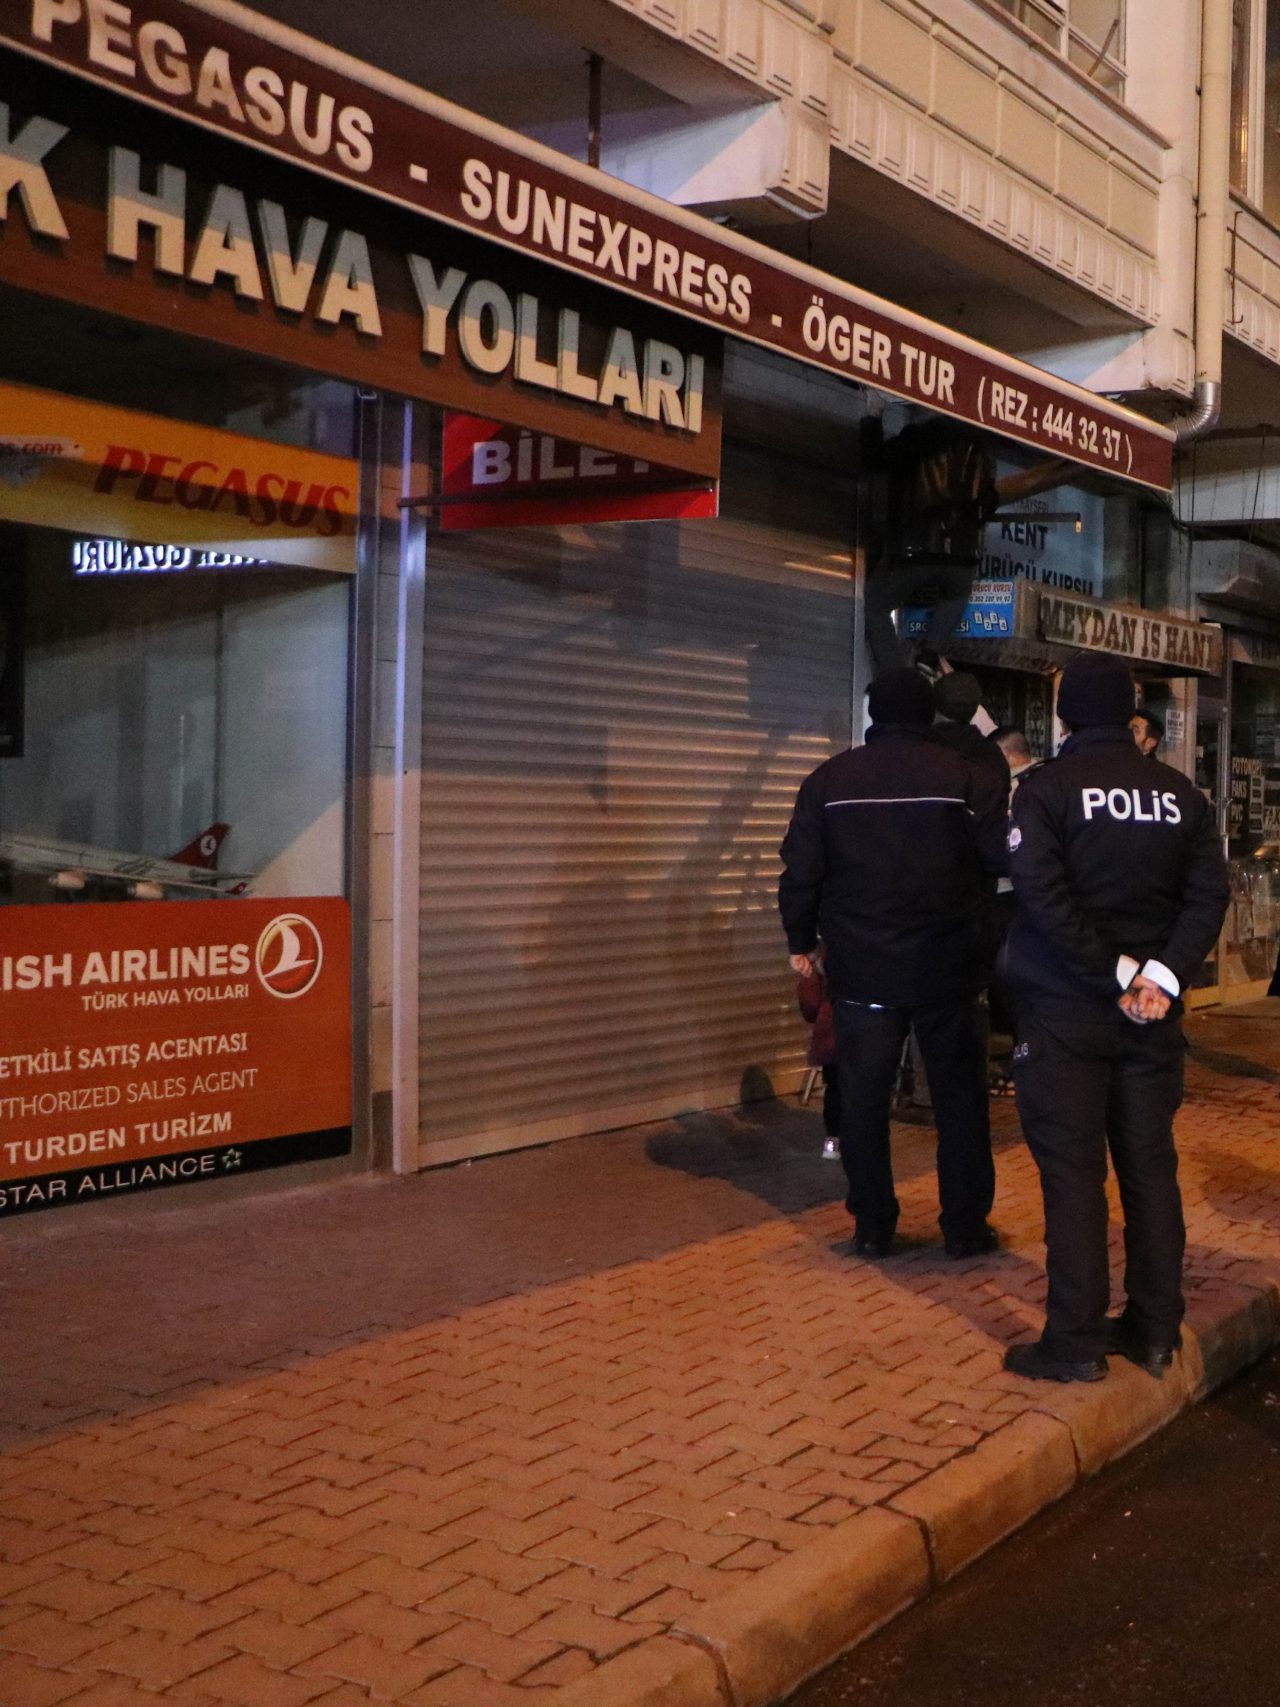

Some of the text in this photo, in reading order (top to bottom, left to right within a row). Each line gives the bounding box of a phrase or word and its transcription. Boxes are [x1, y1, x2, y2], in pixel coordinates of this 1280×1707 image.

[31, 0, 375, 173] PEGASUS
[459, 157, 752, 325] SUNEXPRESS
[801, 295, 891, 381] ÖGER
[899, 341, 955, 405] TUR
[1078, 415, 1099, 454] 32
[107, 145, 382, 338] HAVA
[407, 250, 704, 434] YOLLARI
[472, 429, 650, 486] BİLE
[94, 444, 350, 537] PEGASUS
[1001, 521, 1049, 550] KENT
[977, 549, 1038, 581] ÜRÜCÜ
[1040, 596, 1138, 653] MEYDAN
[0, 943, 251, 991] ISH AIRLINES
[81, 983, 249, 1011] TÜRK HAVA YOLLARI
[77, 1043, 141, 1069] SATIŞ
[145, 1032, 249, 1062] ACENTASI
[126, 1076, 187, 1103] SALES
[192, 1068, 259, 1095] AGENT
[4, 1110, 233, 1165] TURDEN TURİZM
[77, 1154, 216, 1195] ALLIANCE
